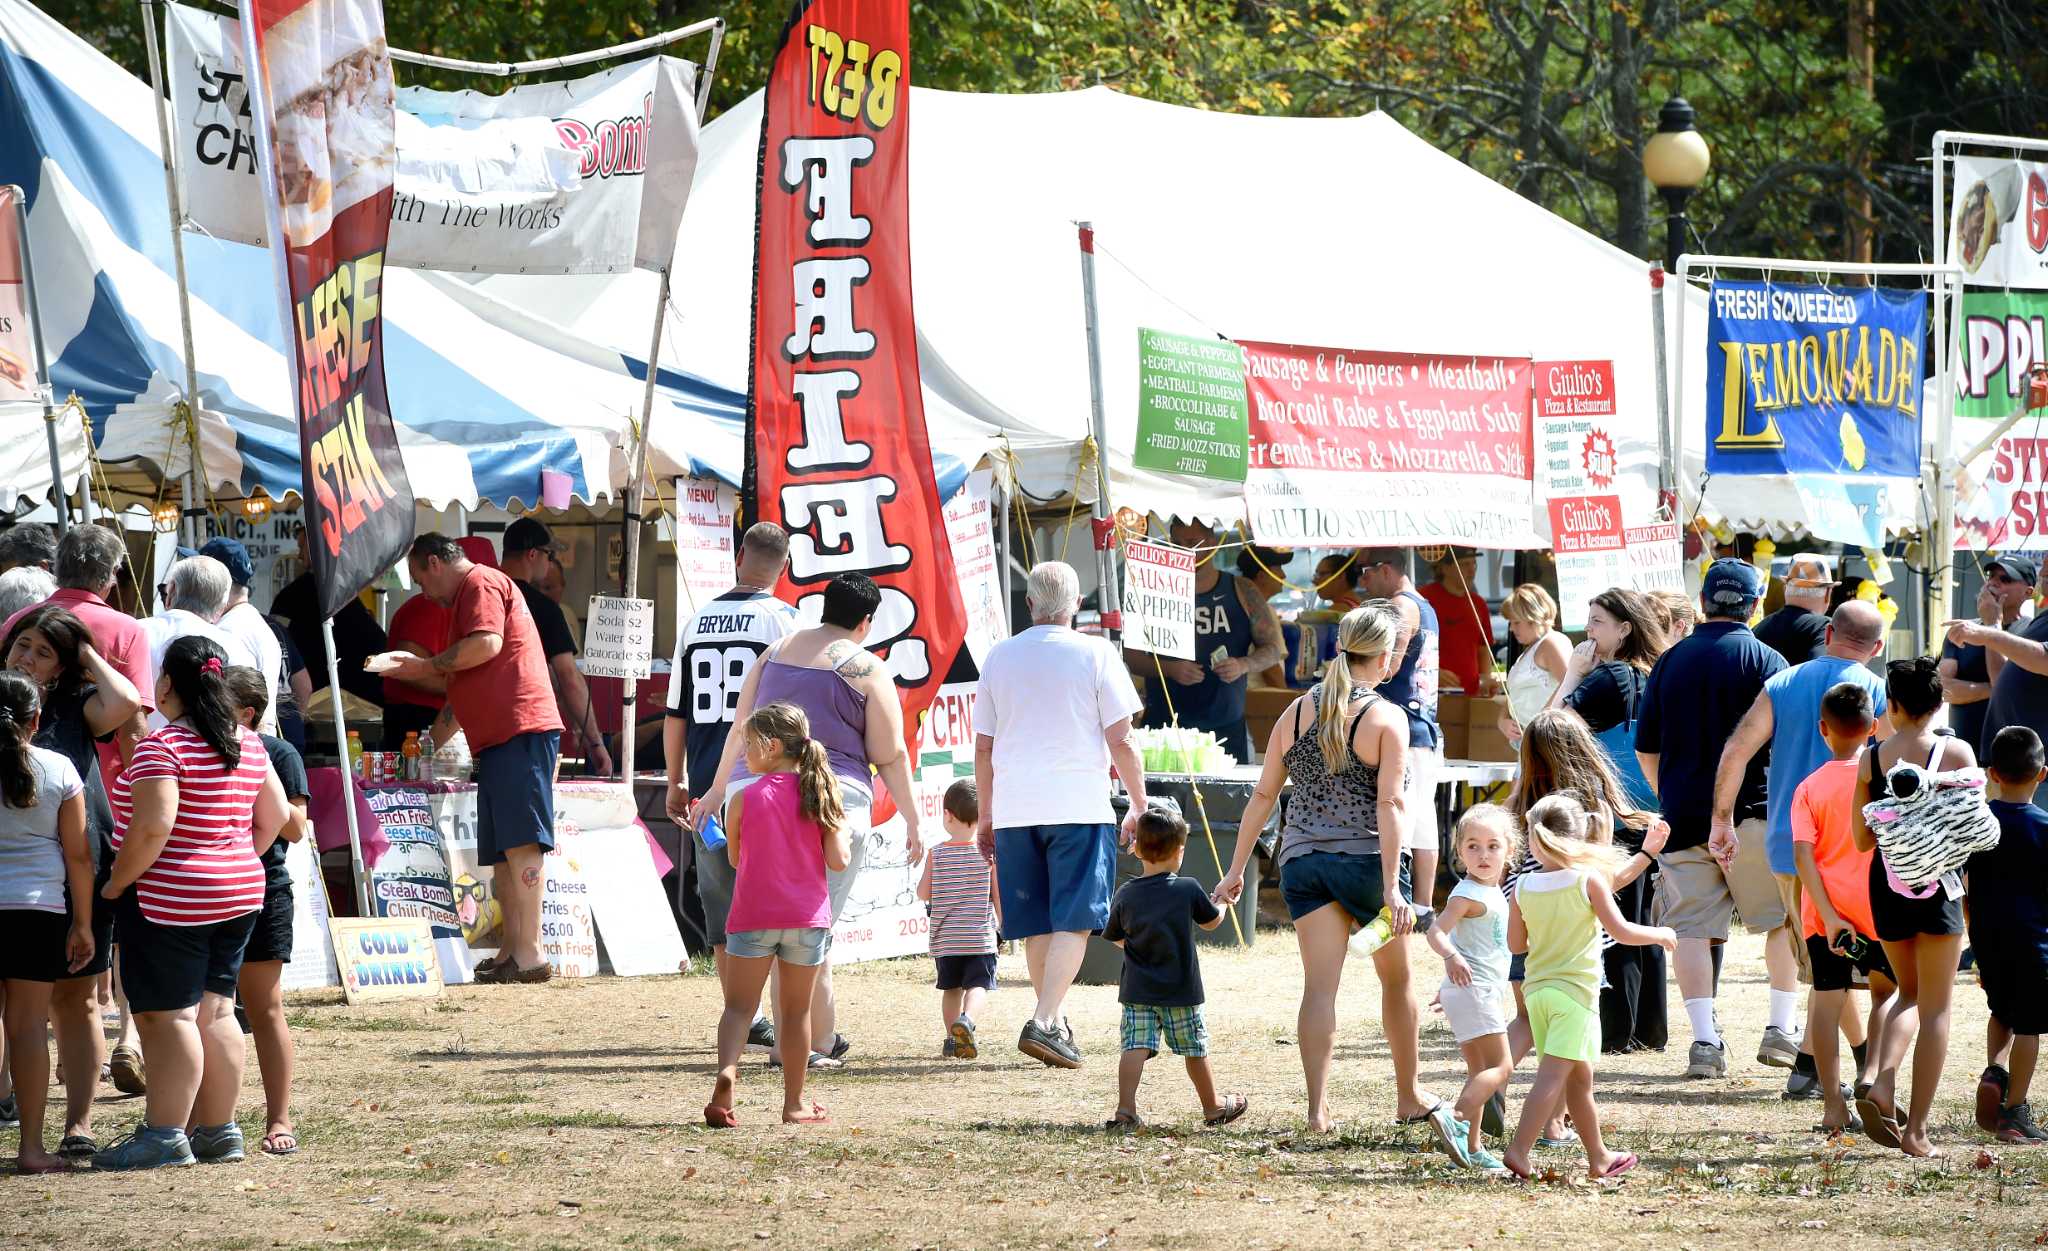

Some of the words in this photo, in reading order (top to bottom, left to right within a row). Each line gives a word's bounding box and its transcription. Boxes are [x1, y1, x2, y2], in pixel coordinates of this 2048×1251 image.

[197, 64, 251, 117] ST
[440, 199, 488, 228] The
[498, 203, 564, 230] Works
[1715, 289, 1768, 320] FRESH
[1771, 291, 1858, 324] SQUEEZED
[1151, 337, 1190, 354] SAUSAGE
[1200, 345, 1238, 364] PEPPERS
[1149, 355, 1196, 376] EGGPLANT
[1199, 363, 1244, 384] PARMESAN
[1241, 345, 1310, 391] Sausage
[1315, 353, 1330, 383] &
[1335, 353, 1405, 396] Peppers
[1427, 359, 1508, 392] Meatball
[1548, 364, 1603, 398] Giulio's
[1149, 374, 1198, 395] MEATBALL
[1199, 382, 1245, 401] PARMESAN
[1714, 325, 1919, 450] LEMONADE
[1155, 395, 1204, 415] BROCCOLI
[1205, 402, 1229, 418] RABE
[1229, 406, 1239, 420] &
[1256, 391, 1330, 427] Broccoli
[1334, 397, 1381, 429] Rabe
[1385, 404, 1400, 429] &
[1399, 399, 1481, 441] Eggplant
[1544, 397, 1566, 415] Pizza
[1566, 398, 1574, 414] &
[1574, 397, 1612, 414] Restaurant
[1174, 417, 1217, 436] SAUSAGE
[1151, 433, 1180, 450] FRIED
[1181, 437, 1208, 455] MOZZ
[1208, 442, 1241, 459] STICKS
[1248, 434, 1314, 467] French
[1316, 436, 1363, 470] Fries
[1367, 440, 1384, 470] &
[1388, 440, 1494, 473] Mozzarella
[1179, 457, 1208, 473] FRIES
[687, 487, 716, 504] MENU
[1562, 501, 1612, 533] Giulio's
[1560, 533, 1580, 550] Pizza
[1580, 534, 1587, 548] &
[1587, 532, 1621, 548] Restaurant
[1126, 543, 1167, 565] GIULIO'S
[1168, 553, 1195, 572] PIZZA
[1128, 565, 1193, 598] SAUSAGE
[599, 599, 642, 612] DRINKS
[1125, 592, 1137, 614] &
[1143, 594, 1193, 625] PEPPER
[597, 614, 625, 628] Soda
[627, 617, 642, 628] $2
[697, 614, 755, 634] BRYANT
[595, 630, 624, 644] Water
[627, 632, 642, 645] $2
[1143, 625, 1179, 651] SUBS
[585, 646, 633, 661] Gatorade
[636, 651, 651, 662] $3
[585, 663, 627, 677] Monster
[632, 668, 647, 678] $4
[691, 647, 758, 724] 88
[932, 693, 976, 748] CEN
[408, 809, 432, 825] Fries
[381, 882, 418, 898] Steak
[422, 884, 451, 902] Bomb
[546, 879, 588, 894] Cheese
[388, 902, 417, 918] Chili
[420, 905, 461, 927] Cheese
[542, 900, 569, 916] Fries
[541, 922, 574, 938] $6.00
[834, 927, 874, 943] Avenue
[898, 917, 929, 937] 203
[359, 932, 410, 956] COLD
[565, 942, 594, 957] Fries
[355, 961, 428, 987] DRINKS
